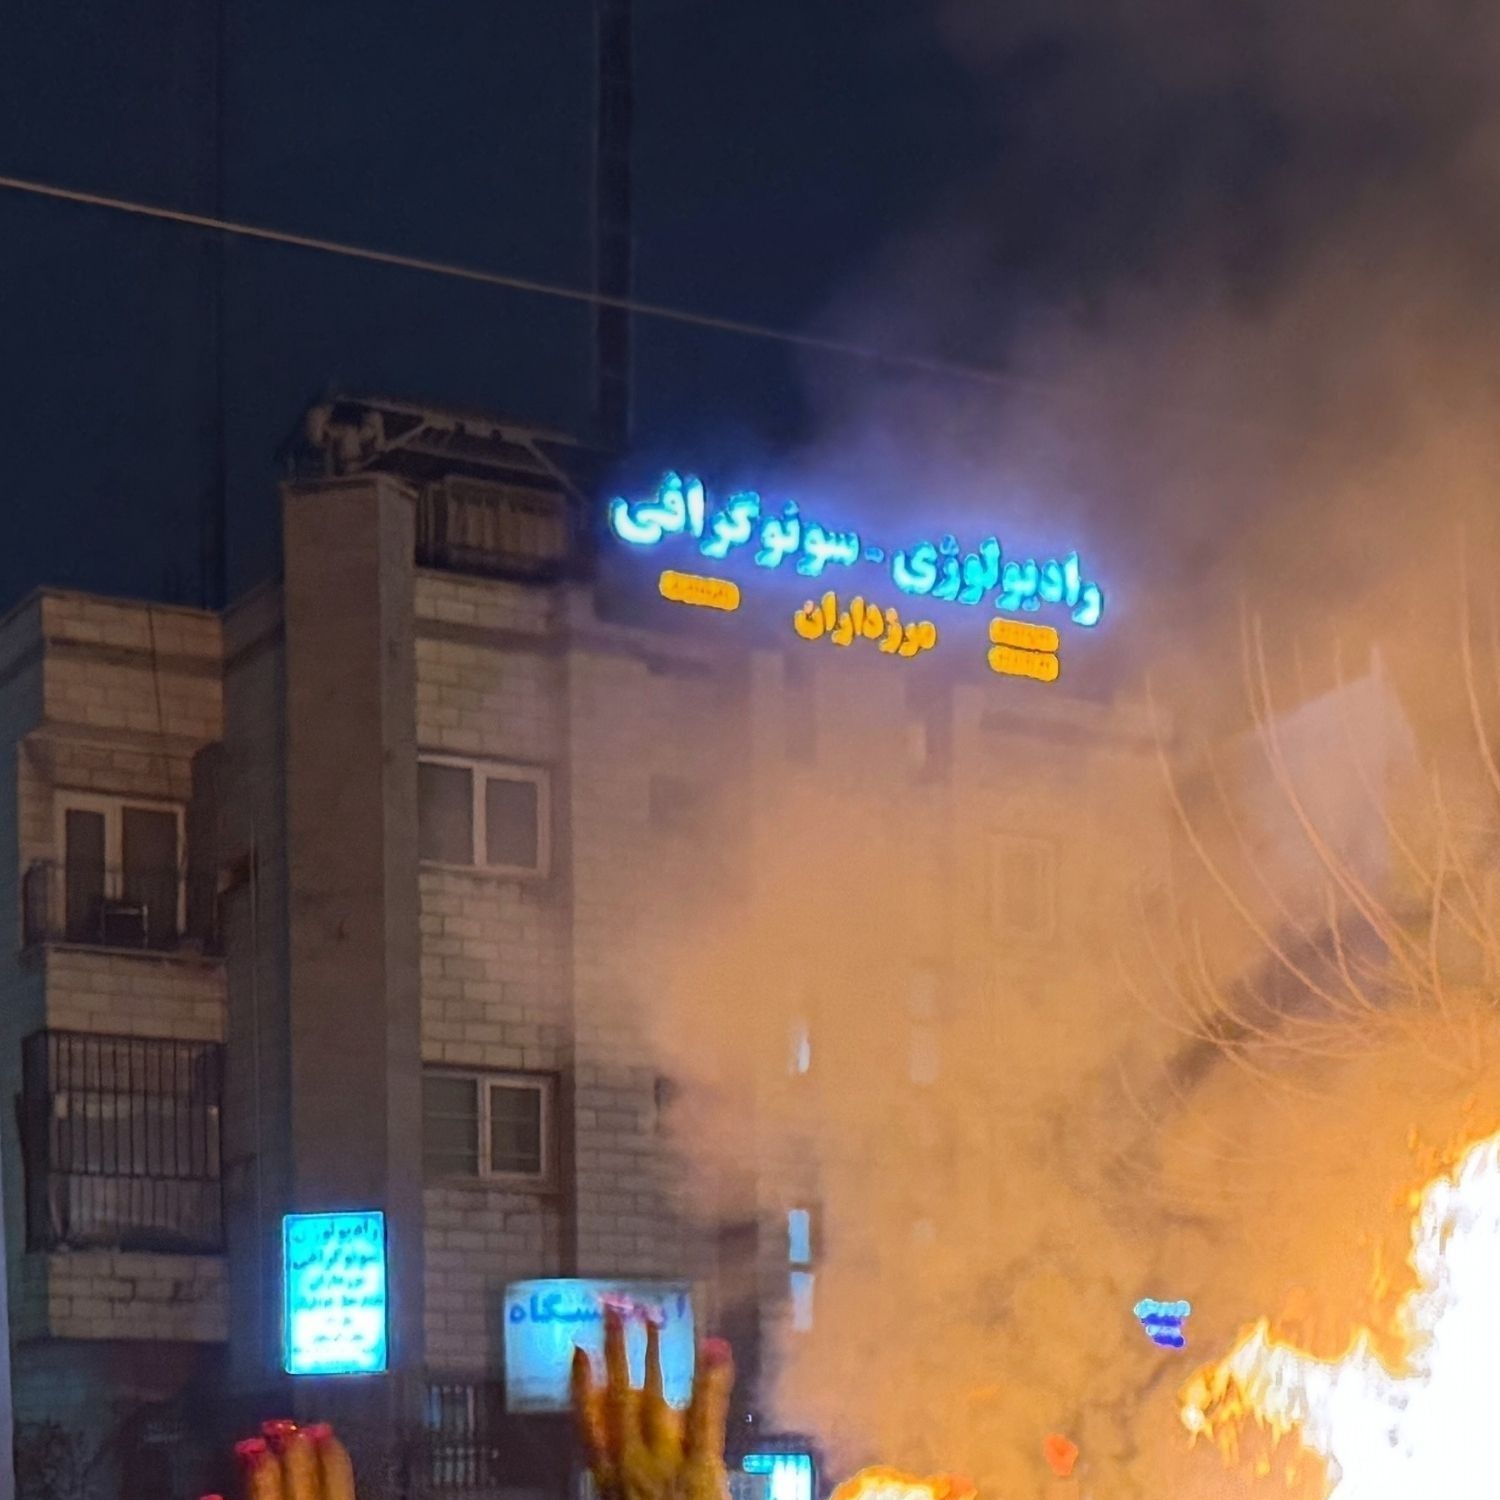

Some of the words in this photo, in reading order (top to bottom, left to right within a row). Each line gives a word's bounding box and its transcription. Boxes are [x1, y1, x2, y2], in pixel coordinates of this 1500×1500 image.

[609, 471, 860, 576] سونوگرافی
[795, 592, 936, 657] مرزداران
[893, 535, 1103, 626] رادیولوژی
